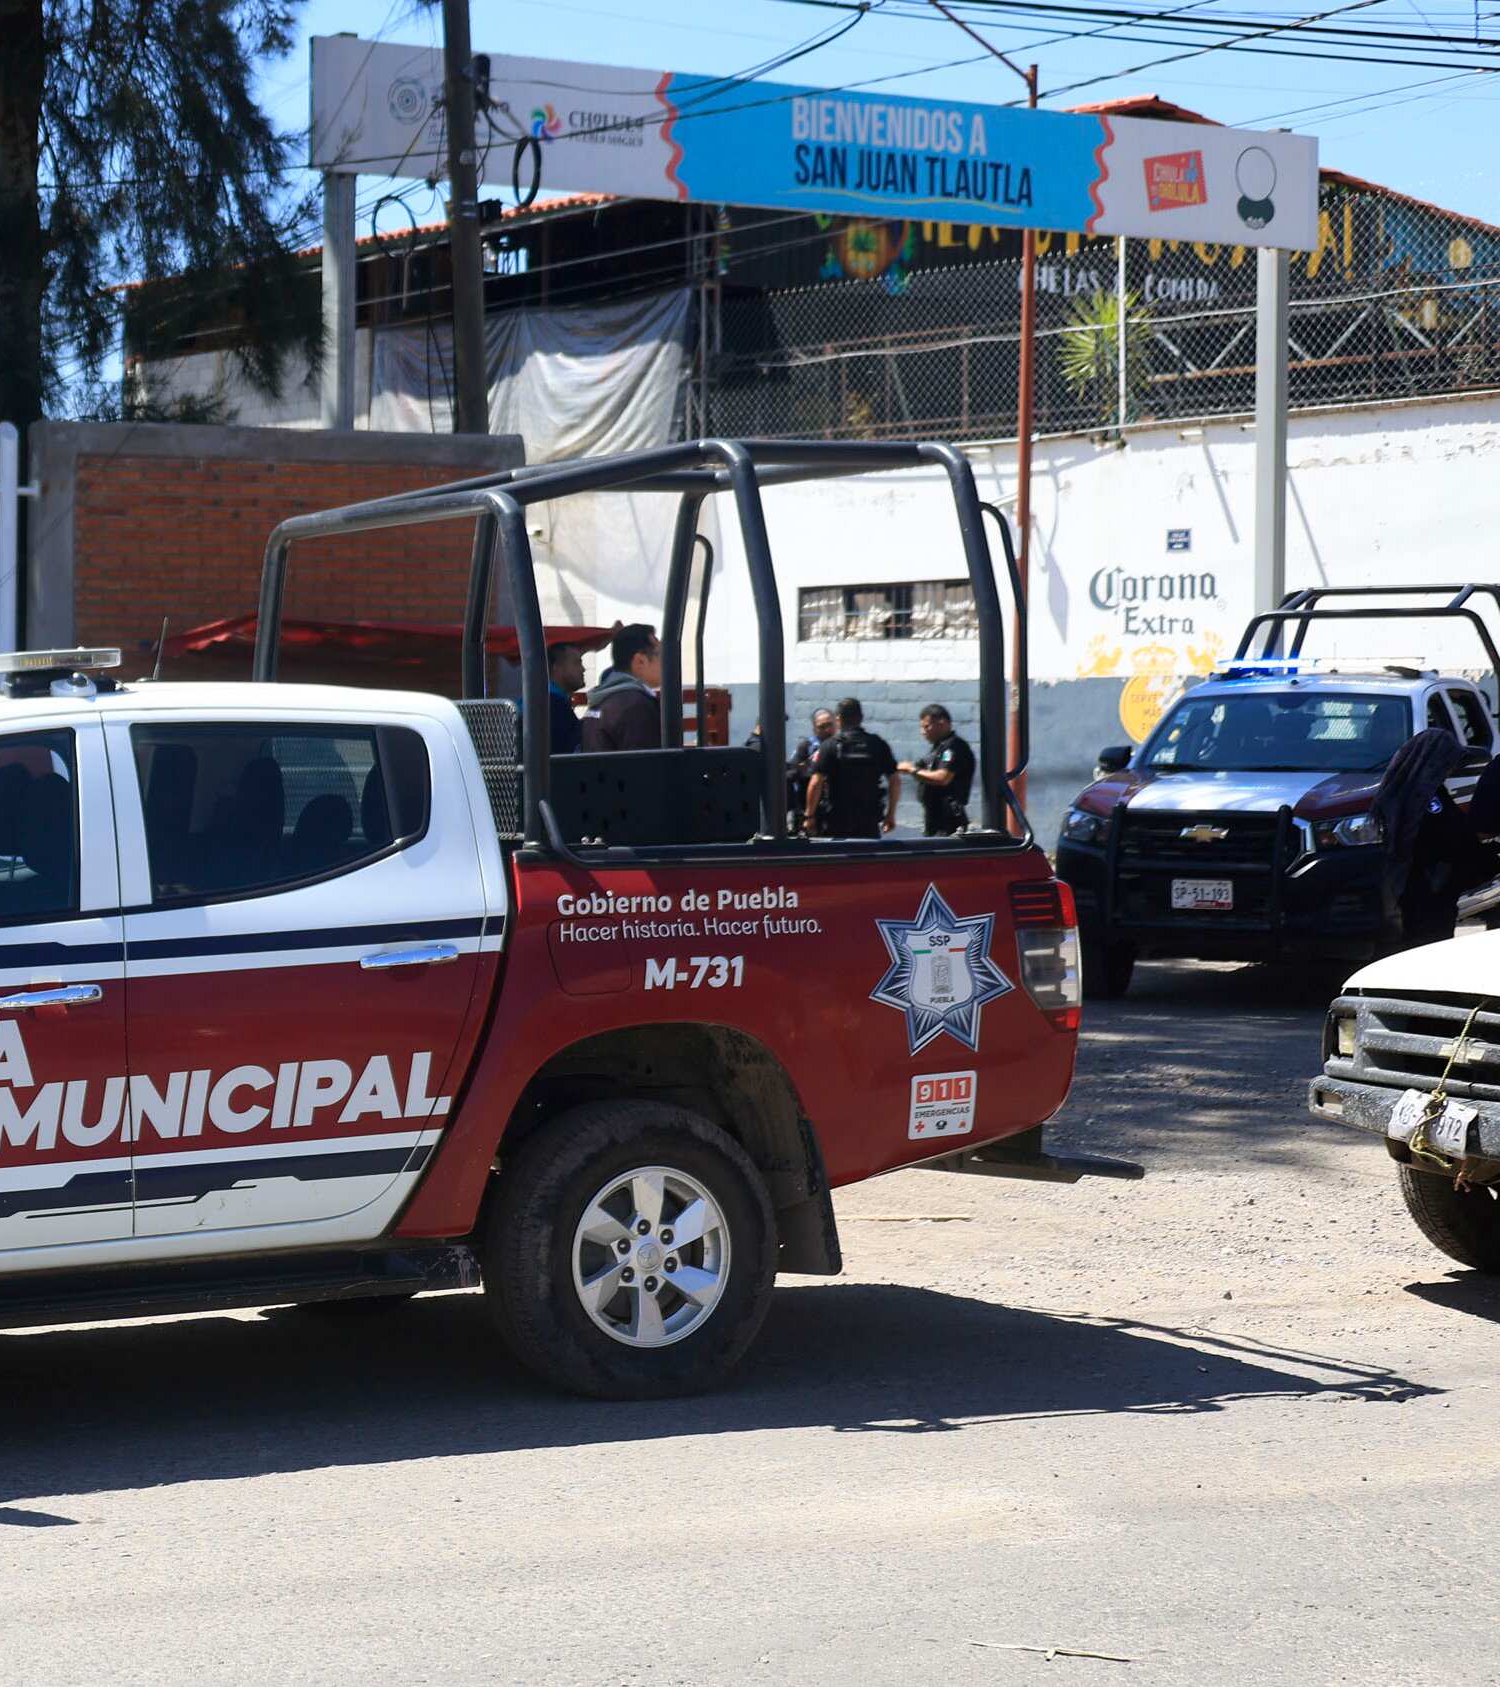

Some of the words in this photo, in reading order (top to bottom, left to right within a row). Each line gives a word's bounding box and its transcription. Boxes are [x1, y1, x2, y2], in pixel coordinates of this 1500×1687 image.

[792, 96, 963, 154] BIENVENIDOS
[969, 113, 988, 157] A
[795, 144, 847, 188] SAN
[855, 147, 917, 195] JUAN
[925, 157, 1033, 207] TLAUTLA
[1089, 565, 1219, 611] Corona
[1123, 605, 1195, 635] Extra
[556, 889, 673, 916] Gobierno
[680, 888, 710, 912] de
[717, 885, 799, 911] Puebla
[560, 921, 618, 943] Hacer
[621, 917, 700, 939] historia.
[703, 916, 759, 936] Hacer
[761, 913, 823, 939] futuro.
[928, 935, 951, 947] SSP
[643, 955, 745, 991] M-731
[920, 1080, 967, 1101] 911
[915, 1105, 970, 1119] EMERGENCIAS
